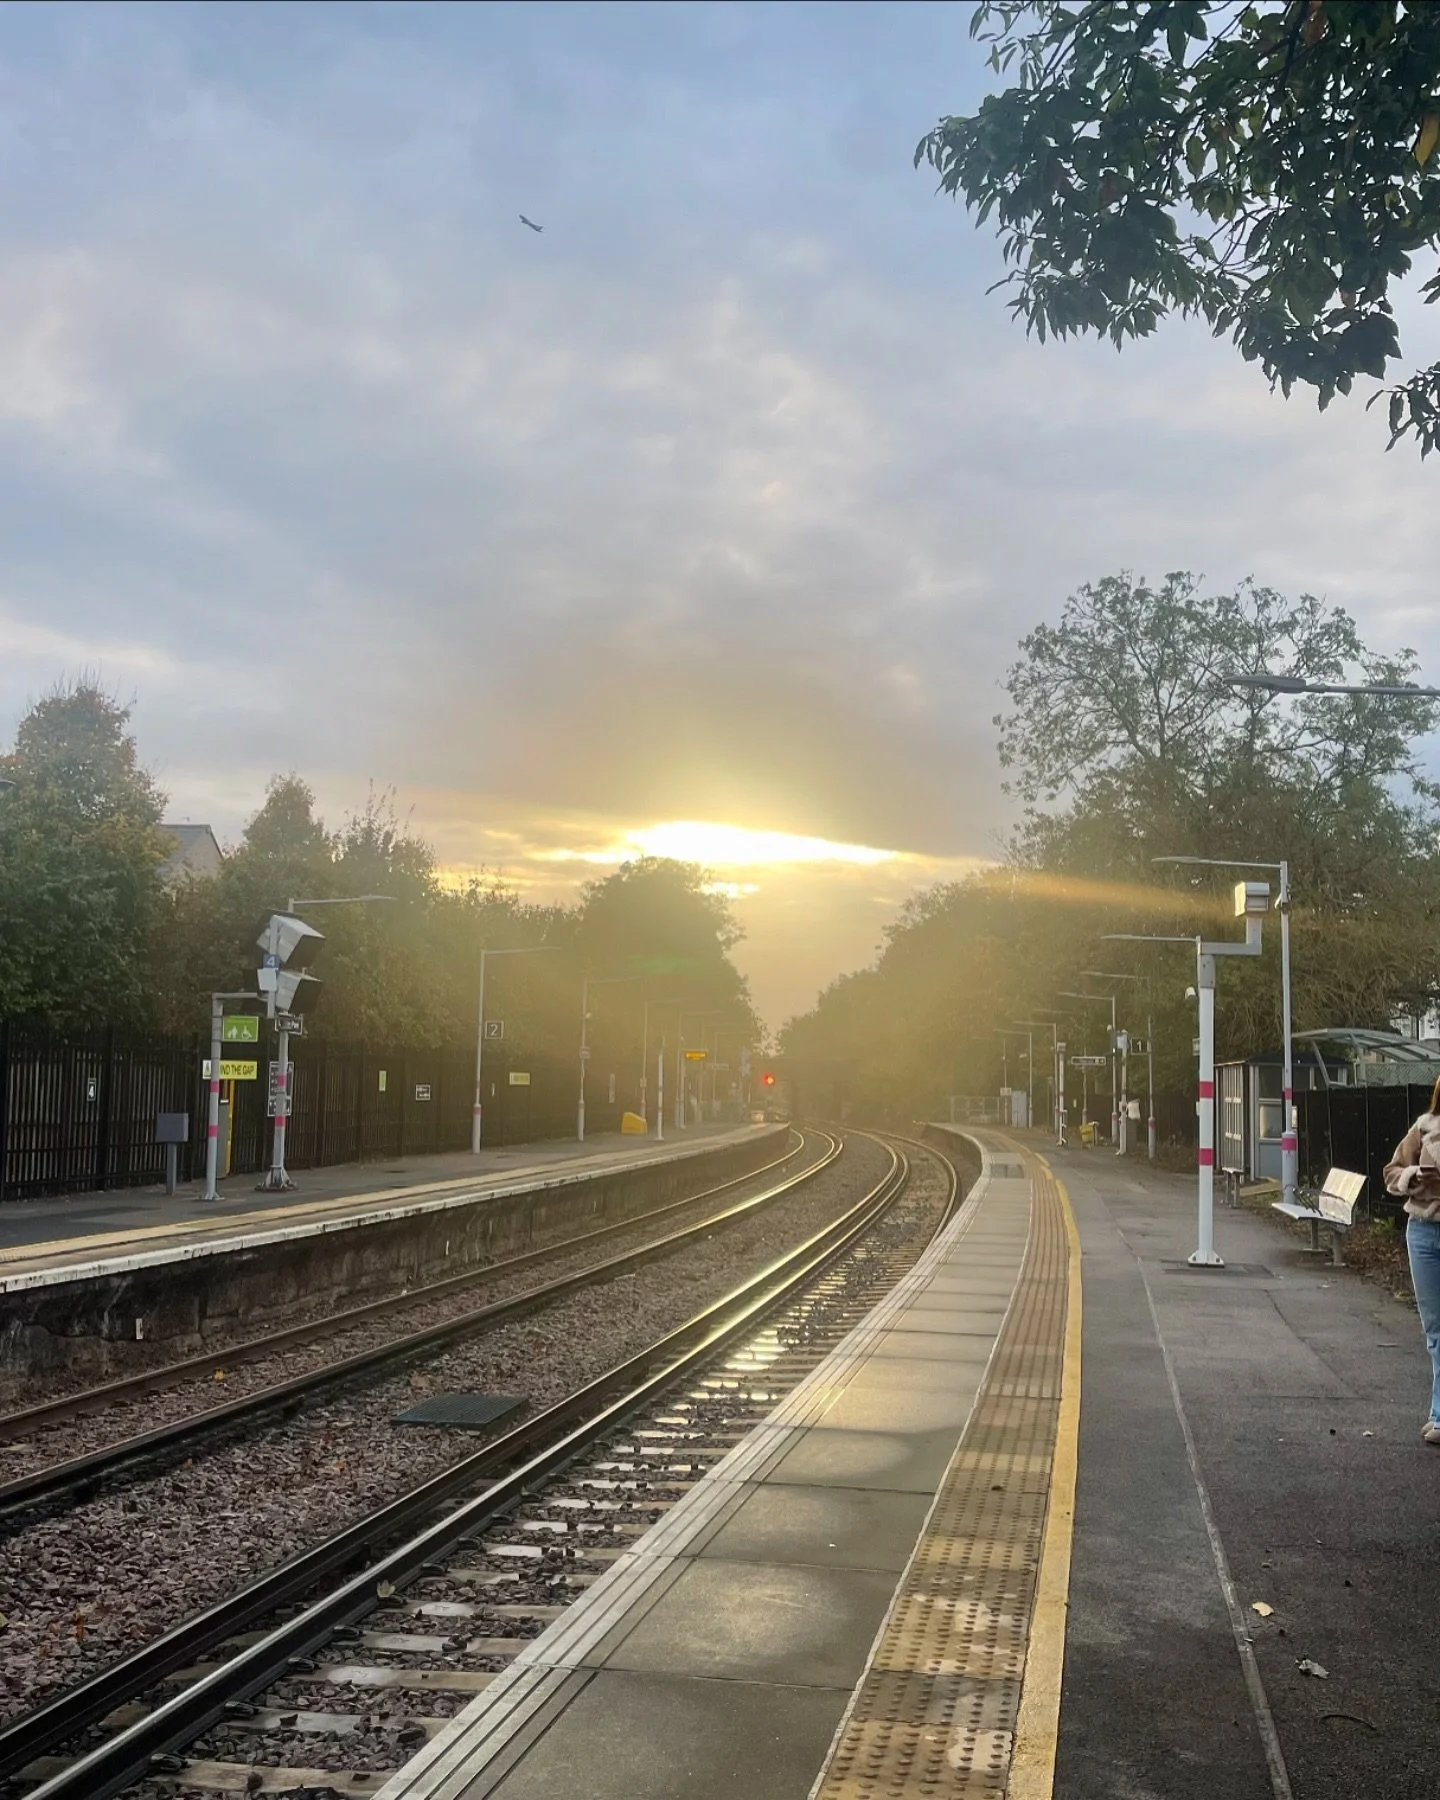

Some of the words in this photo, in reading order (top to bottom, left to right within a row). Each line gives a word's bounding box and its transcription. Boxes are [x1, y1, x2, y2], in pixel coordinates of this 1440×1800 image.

[266, 956, 275, 967] 4
[490, 1023, 498, 1036] 2
[1136, 1040, 1142, 1052] 1
[231, 1064, 241, 1076] THE
[242, 1064, 255, 1076] GAP
